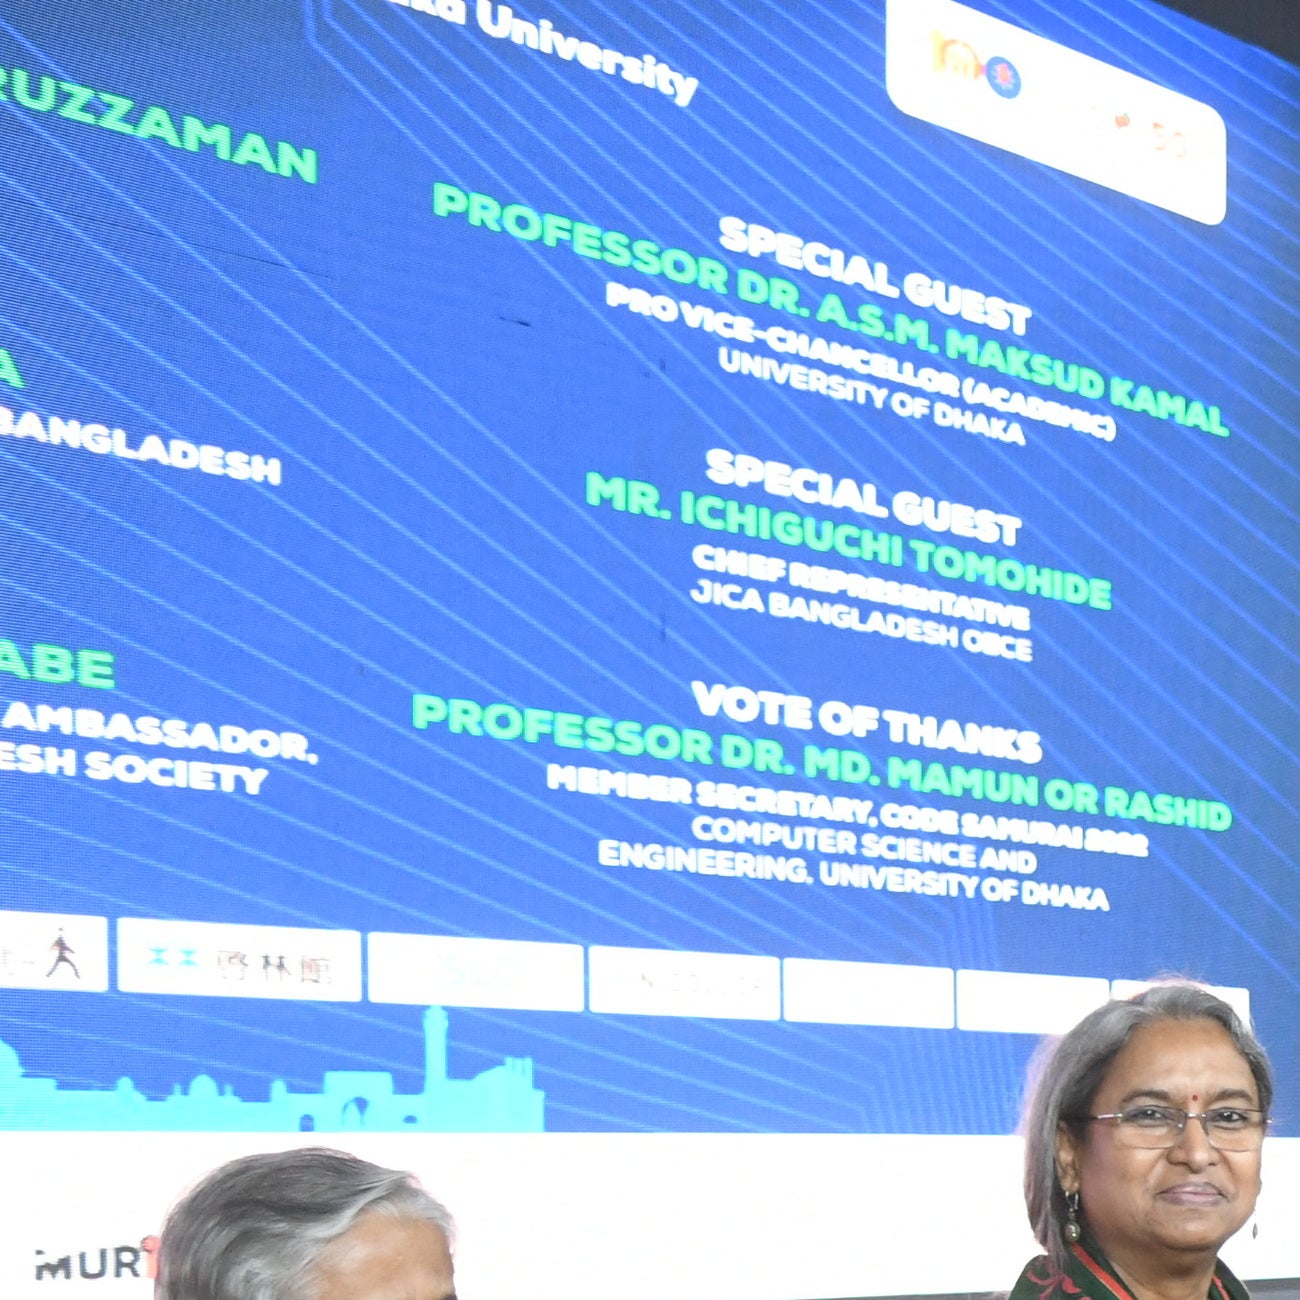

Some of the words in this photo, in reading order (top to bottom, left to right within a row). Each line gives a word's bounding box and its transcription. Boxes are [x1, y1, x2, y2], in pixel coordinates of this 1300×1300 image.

[477, 0, 698, 106] University
[434, 183, 728, 293] PROFESSOR
[738, 269, 810, 317] DR.
[817, 294, 939, 353] A.S.M.
[946, 330, 1106, 398] MAKSUD
[1110, 378, 1230, 437] KAMAL
[720, 217, 899, 298] SPECIAL
[904, 273, 1031, 335] GUEST
[719, 347, 888, 409] UNIVERSITY
[892, 390, 929, 418] OF
[934, 406, 1026, 447] DHAKA
[963, 378, 1116, 441] (ACADEMIC)
[707, 449, 888, 517] SPECIAL
[893, 492, 1022, 545] GUEST
[587, 472, 671, 519] MR.
[682, 492, 903, 566] ICHIGUCHI
[910, 540, 1112, 610] TOMOHIDE
[693, 545, 786, 581] CHIEF
[691, 580, 764, 612] JICA
[770, 593, 958, 647] BANGLADESH
[413, 695, 713, 764] PROFESSOR
[721, 734, 794, 775] DR.
[805, 746, 880, 785] MD.
[888, 757, 1039, 806] MAMUN
[1043, 778, 1100, 814] OR
[1105, 786, 1232, 831] RASHID
[692, 681, 812, 729] VOTE
[826, 701, 879, 737] OF
[884, 710, 1042, 763] THANKS
[85, 752, 268, 794] SOCIETY
[548, 764, 692, 803] MEMBER
[881, 803, 960, 834] CODE
[692, 816, 856, 854] COMPUTER
[862, 833, 976, 867] SCIENCE
[980, 848, 1037, 873] AND
[820, 861, 979, 897] UNIVERSITY
[982, 878, 1018, 901] OF
[1023, 881, 1109, 911] DHAKA
